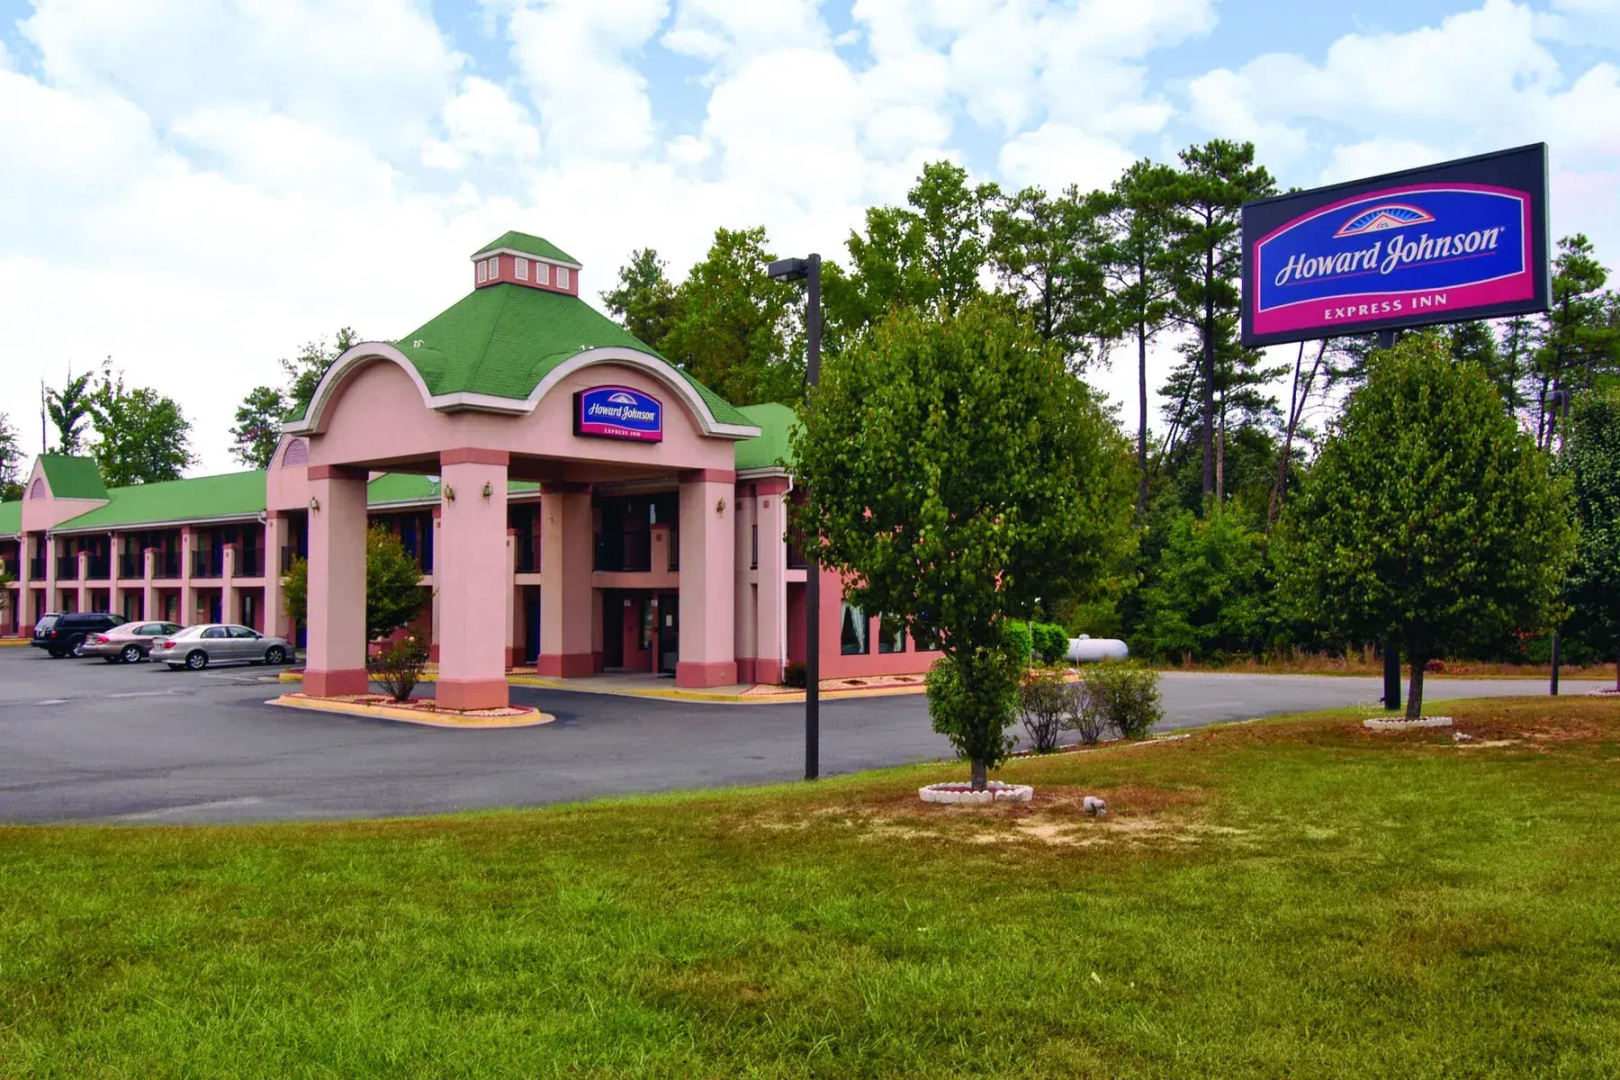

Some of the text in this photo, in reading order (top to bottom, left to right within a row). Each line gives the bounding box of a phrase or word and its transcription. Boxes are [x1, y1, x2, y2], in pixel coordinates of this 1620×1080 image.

[1274, 229, 1498, 286] Howard Johnson
[1324, 294, 1448, 320] EXPRESS INN
[588, 403, 655, 421] Howard Johnson
[604, 428, 628, 436] EXPRESS
